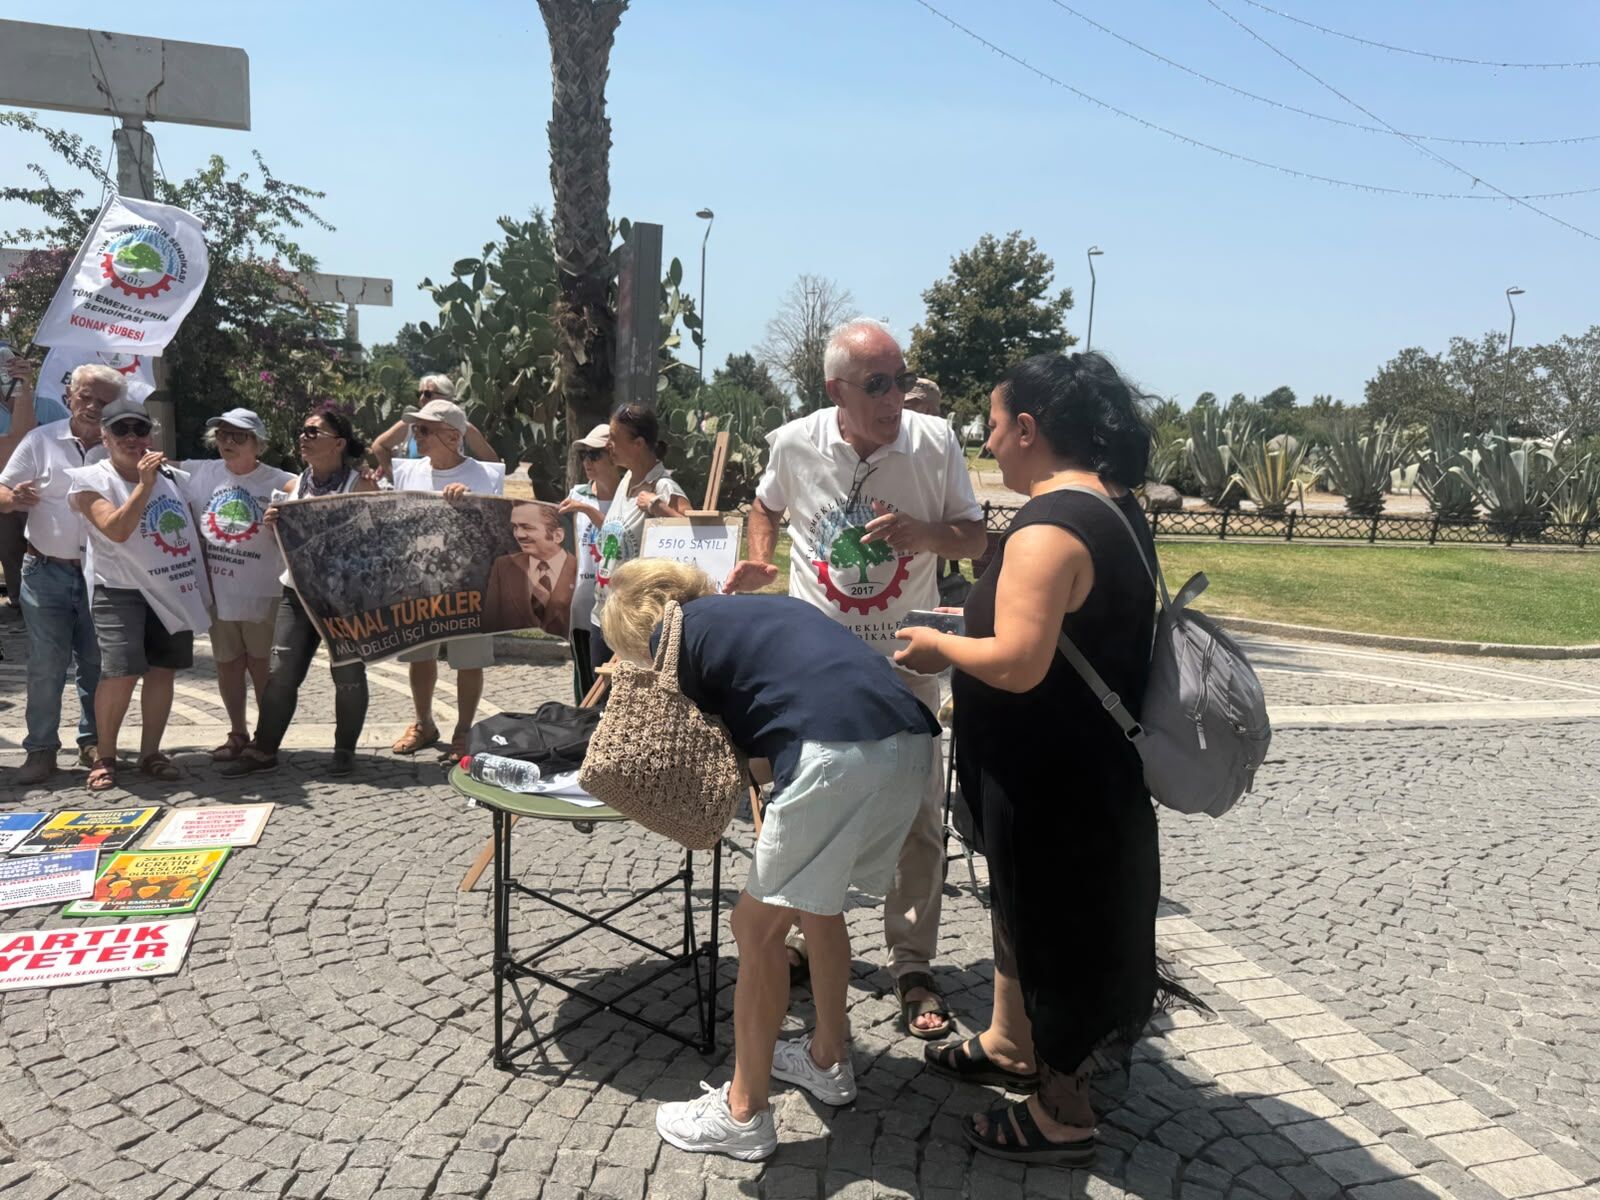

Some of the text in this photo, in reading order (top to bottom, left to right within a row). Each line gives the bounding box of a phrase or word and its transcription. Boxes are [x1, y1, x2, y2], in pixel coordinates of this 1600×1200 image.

[121, 273, 145, 287] 2017
[72, 289, 169, 322] TÜM EMEKLİLERİN
[83, 302, 144, 324] SENDİKASI
[70, 314, 146, 342] KONAK ŞUBESİ
[658, 538, 727, 551] 5510 SAYILI
[207, 552, 245, 566] ENDİKASI
[148, 565, 169, 576] TÜM
[851, 586, 874, 595] 2017
[390, 591, 482, 628] TÜRKLER
[403, 624, 424, 644] İŞÇİ
[429, 614, 481, 635] ÖNDERİ
[143, 854, 200, 862] SEFALET
[0, 924, 170, 953] ARTIK
[0, 942, 169, 972] YETER
[0, 966, 131, 983] EMEKLİLERİN SENDİKASI
